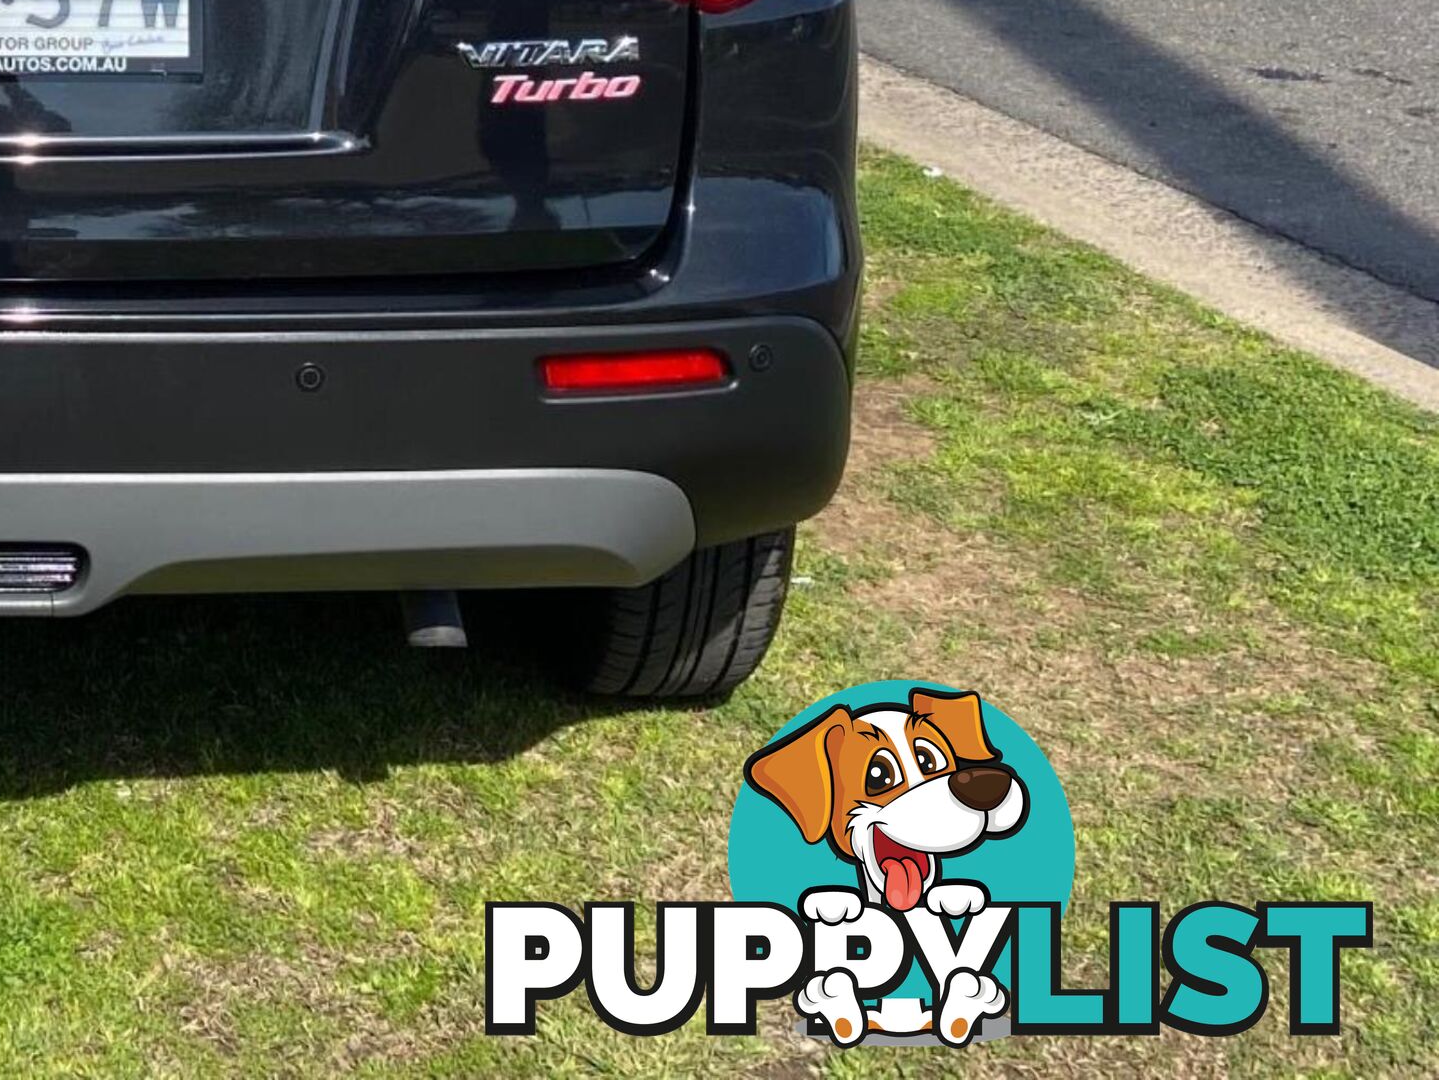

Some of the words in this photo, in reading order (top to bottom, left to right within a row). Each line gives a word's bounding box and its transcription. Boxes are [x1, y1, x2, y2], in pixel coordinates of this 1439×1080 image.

[33, 36, 94, 51] GROUP
[456, 34, 640, 68] VITARA
[490, 71, 641, 104] Turbo
